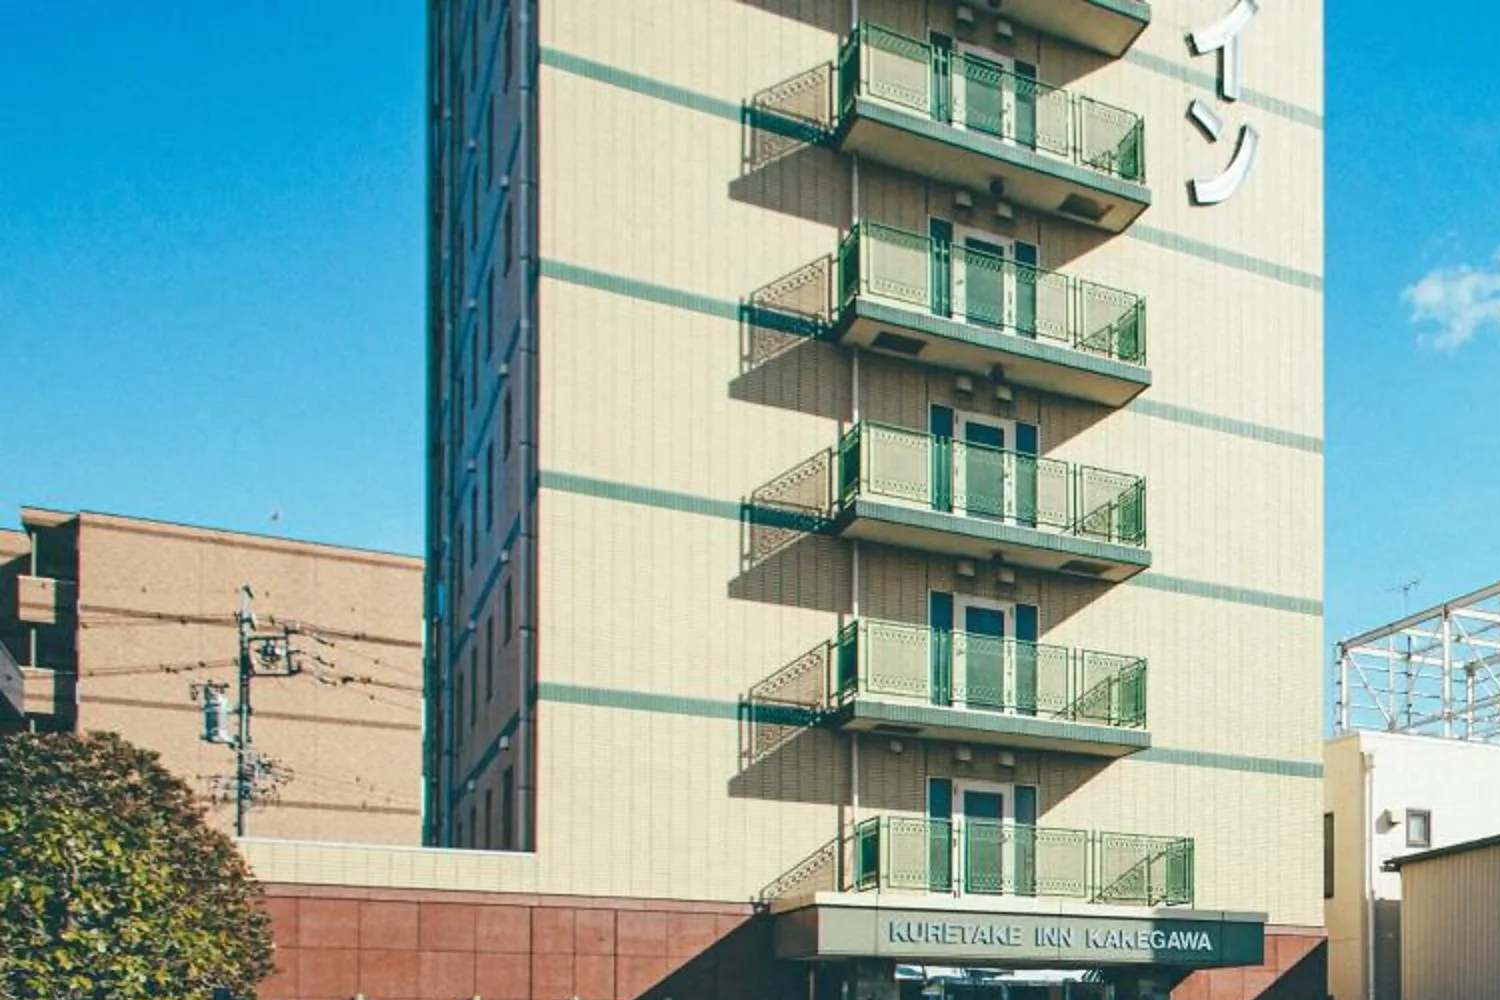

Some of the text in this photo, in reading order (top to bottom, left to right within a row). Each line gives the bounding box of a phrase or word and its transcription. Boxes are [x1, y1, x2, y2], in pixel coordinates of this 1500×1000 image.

[889, 920, 1212, 951] KURETAKE INN KAKEGAWA
